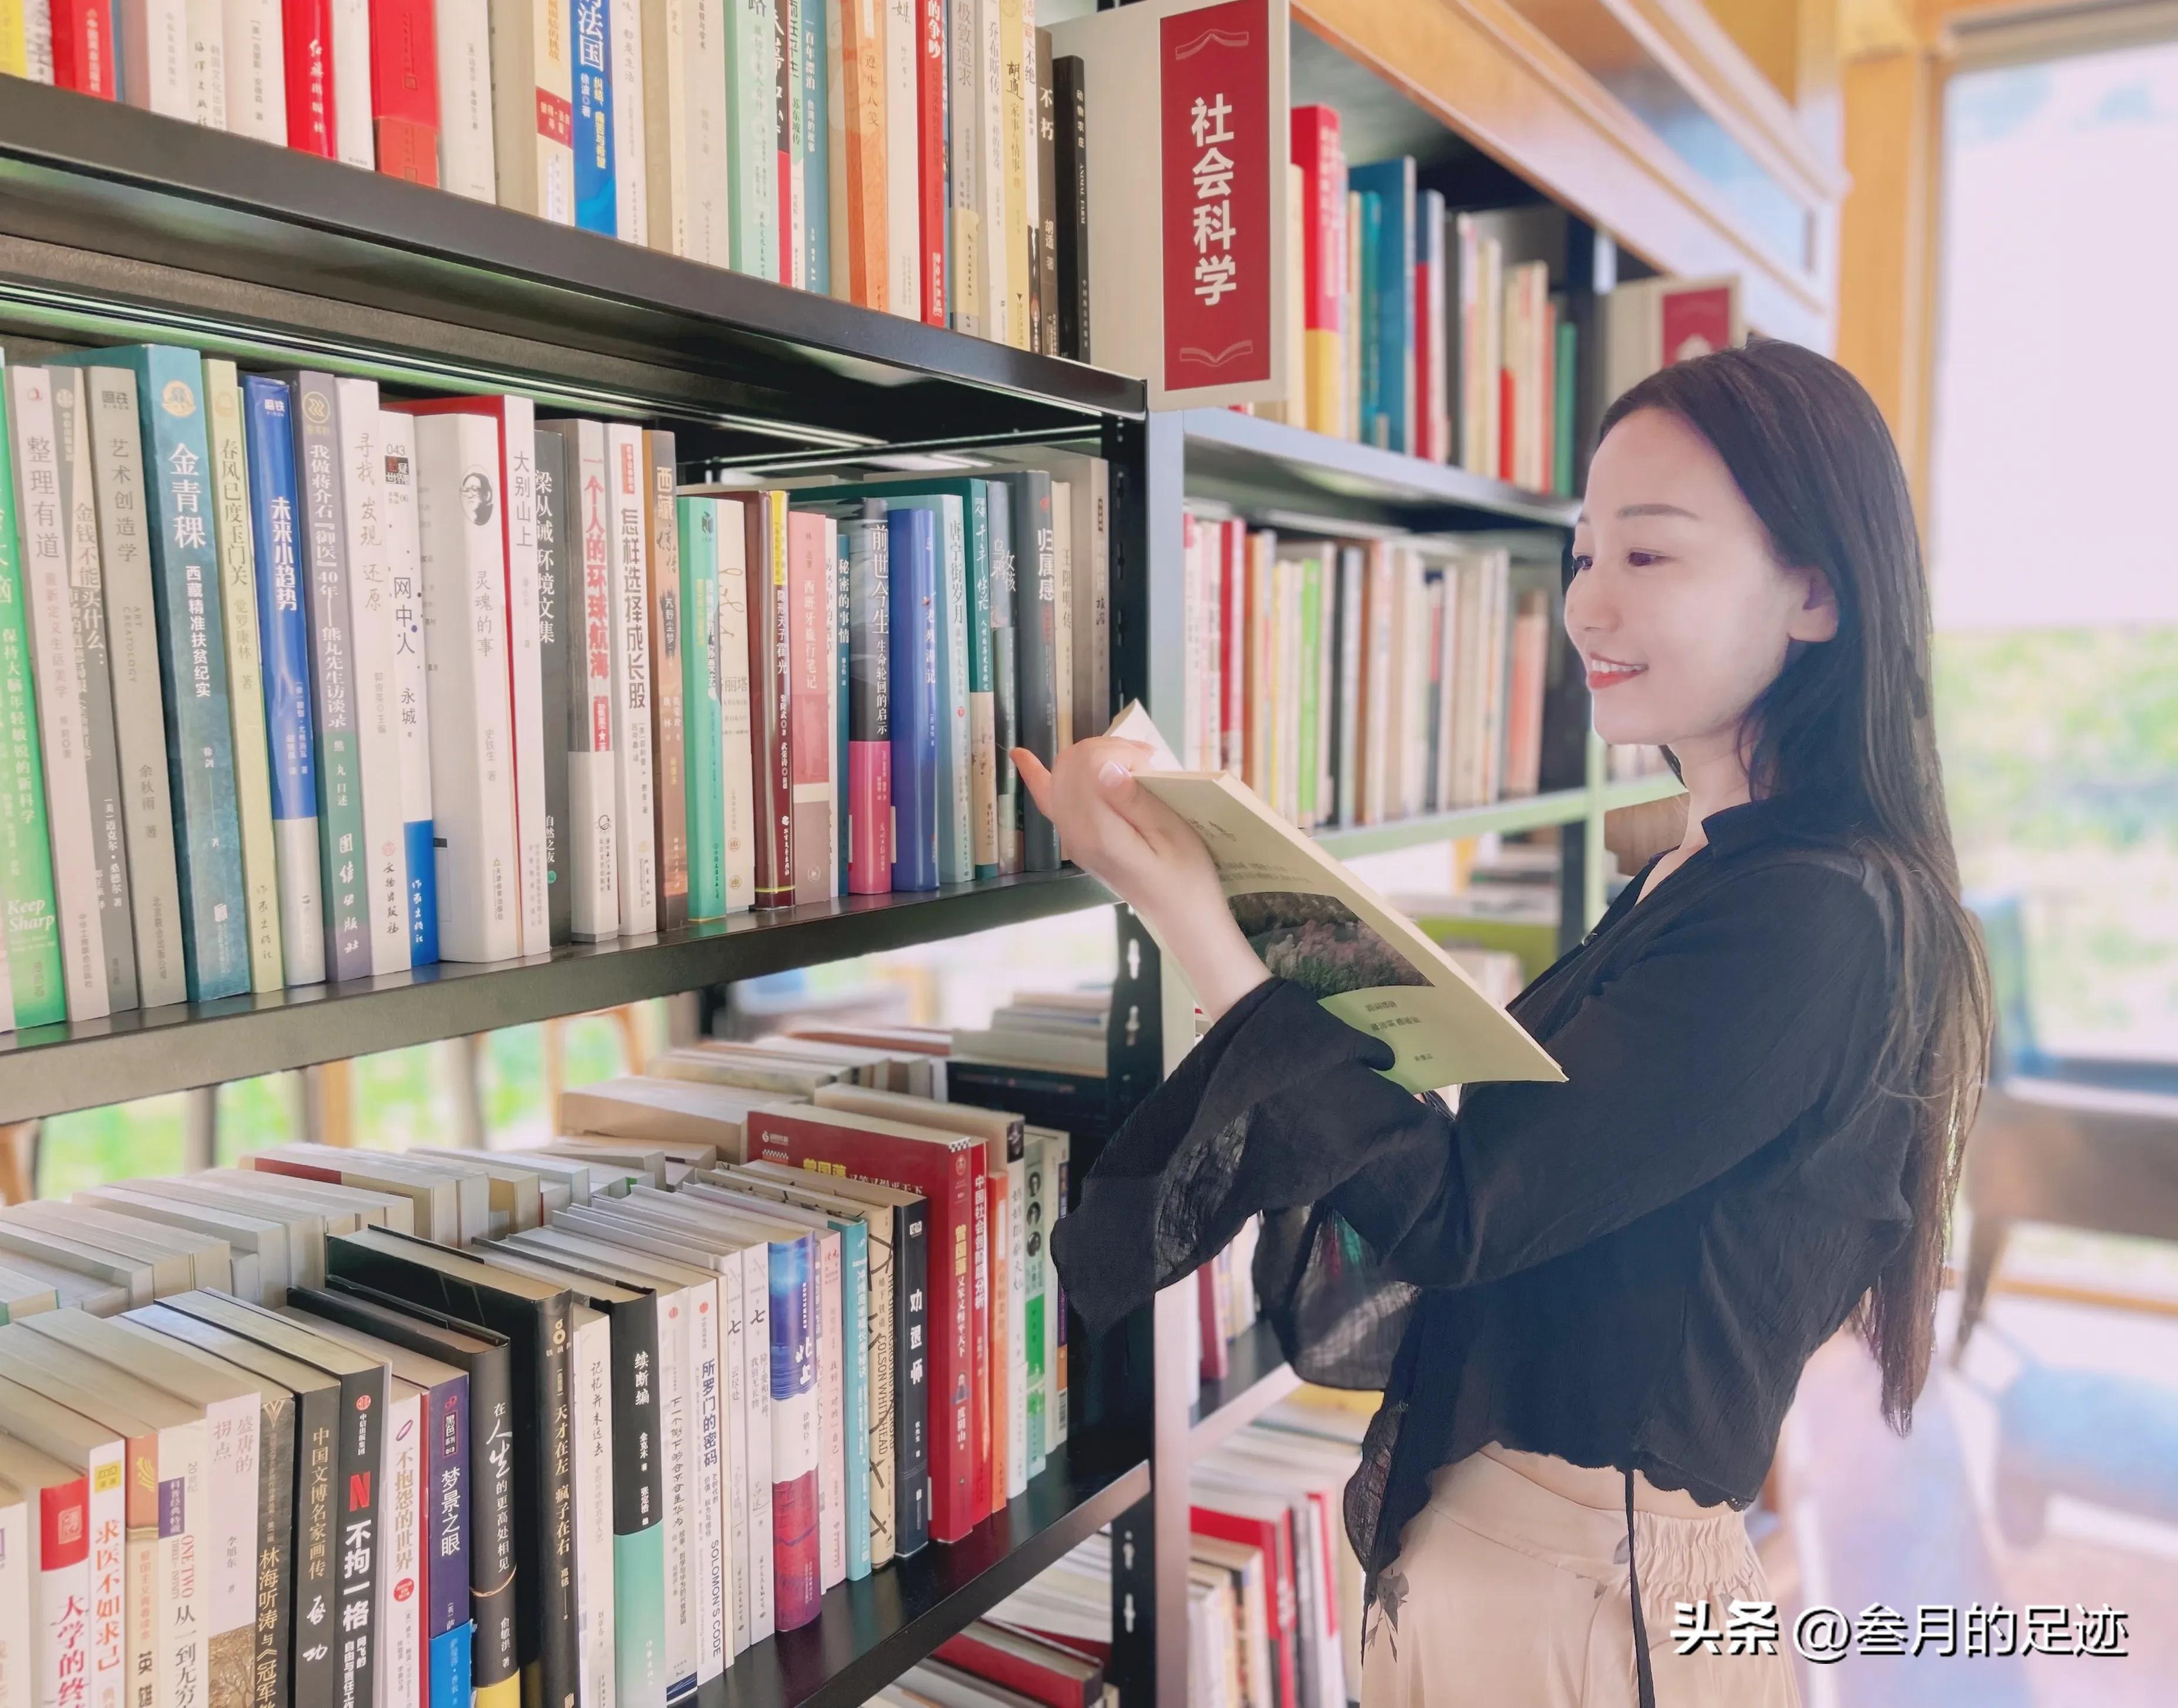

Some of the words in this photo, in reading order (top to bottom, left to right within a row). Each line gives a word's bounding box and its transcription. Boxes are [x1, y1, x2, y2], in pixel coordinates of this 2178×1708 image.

[578, 0, 604, 72] 法国
[957, 2, 971, 87] 极致追求
[1040, 86, 1054, 141] 不朽
[1191, 93, 1236, 306] 社会科学
[27, 437, 59, 558] 整理有道
[109, 438, 138, 562] 艺术创造学
[169, 443, 206, 550] 金青稞
[220, 438, 249, 586] 春风已度玉门关
[514, 451, 532, 547] 大别山上
[271, 497, 296, 611] 未来小趋势
[583, 458, 609, 679] 一个人的环球航海
[871, 524, 889, 634] 前世今生
[950, 520, 963, 624] 唐宁街岁月
[1037, 528, 1054, 601] 归属感
[186, 565, 211, 698] 西藏精准扶贫纪实
[394, 577, 415, 655] 网中人
[474, 571, 493, 657] 灵魂的事
[622, 508, 645, 709] 怎样选择成长股
[805, 580, 817, 689] 西班牙旅行笔记
[839, 559, 849, 643] 秘密的事情
[401, 688, 417, 724] 永城
[876, 640, 887, 735] 生命轮回的启示
[139, 764, 155, 811] 余秋雨
[546, 815, 555, 863] 自然之友
[8, 899, 45, 915] Keep
[9, 915, 55, 932] Sharp
[634, 1351, 649, 1405] 续断编
[796, 1337, 813, 1385] 北上
[878, 1335, 887, 1381] COLSON
[213, 1420, 232, 1462] 拐点
[235, 1415, 254, 1474] 盛唐的
[358, 1414, 367, 1456] 中信出版集团
[554, 1404, 569, 1476] 天才在左
[639, 1432, 648, 1459] 金克木
[702, 1359, 717, 1468] 所罗门的密码
[878, 1384, 889, 1455] WHITEHEAD
[309, 1428, 330, 1580] 中国文博名家画传
[350, 1471, 370, 1512] N
[395, 1447, 413, 1573] 不抱怨的世界
[441, 1467, 460, 1557] 梦景之眼
[487, 1402, 512, 1573] 在人生的更高处相见
[555, 1484, 570, 1556] 疯子在右
[182, 1535, 194, 1563] ONE
[182, 1566, 194, 1598] TWO
[343, 1519, 371, 1632] 不拘一格
[711, 1539, 721, 1617] SOLOMON'S
[96, 1519, 120, 1672] 求医不如求己
[500, 1617, 510, 1652] 俞敏洪
[57, 1595, 85, 1708] 大学的终
[175, 1605, 196, 1708] 从一到无穷
[712, 1620, 721, 1658] CODE
